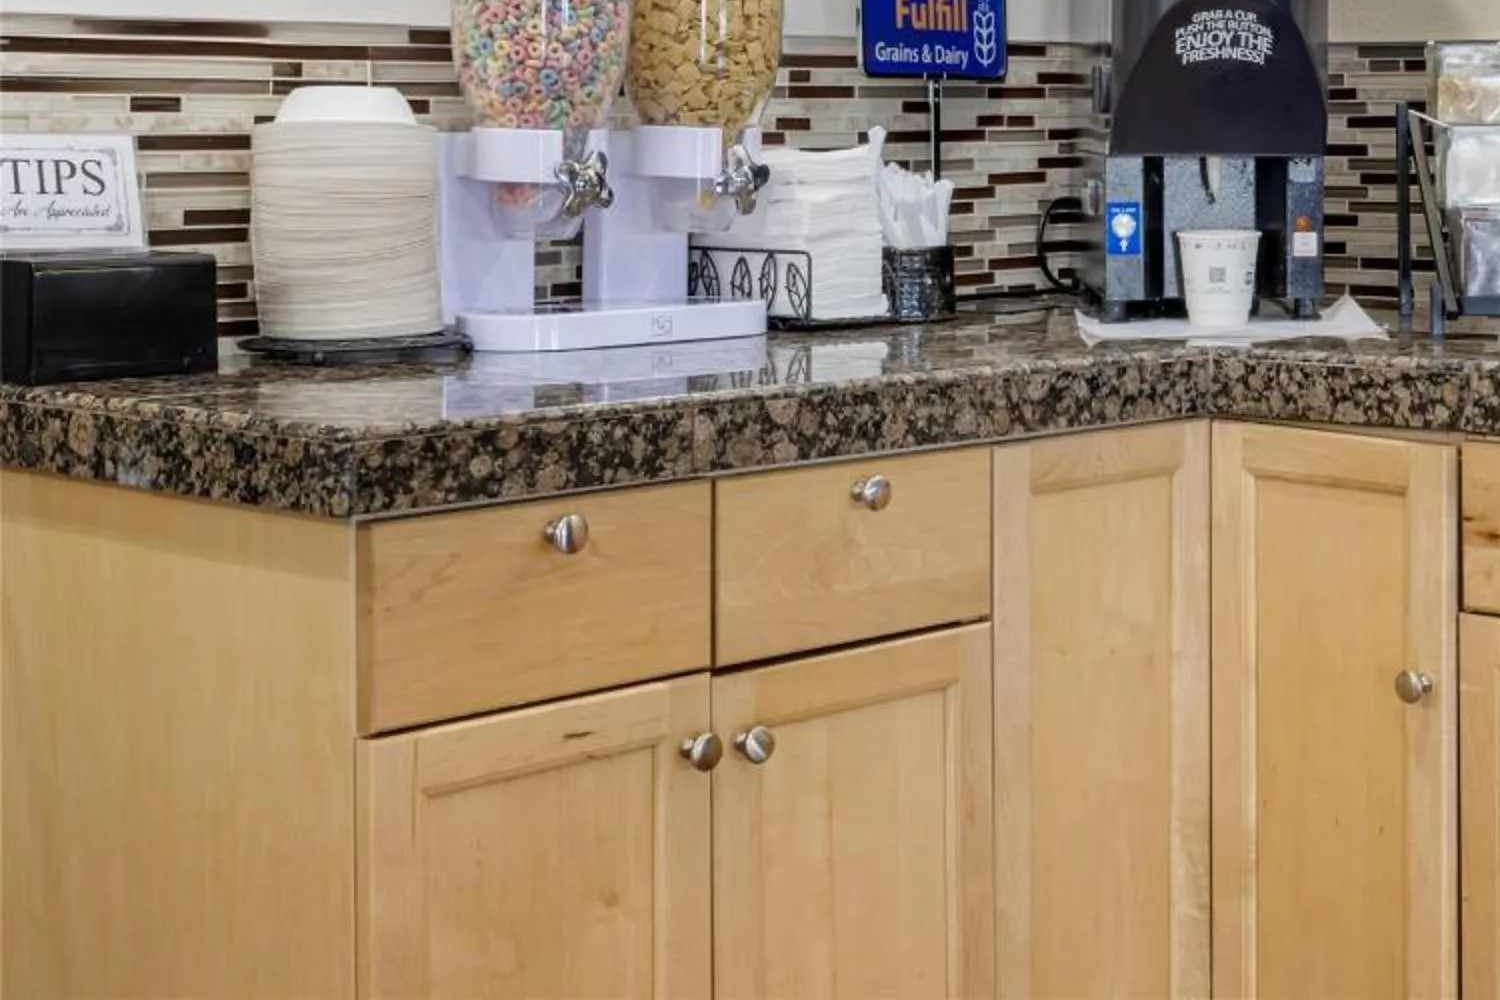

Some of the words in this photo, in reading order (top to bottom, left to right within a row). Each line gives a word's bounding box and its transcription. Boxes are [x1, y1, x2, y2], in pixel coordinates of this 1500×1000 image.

[1203, 20, 1227, 31] THE
[875, 41, 919, 64] Grains
[922, 44, 932, 64] &
[935, 45, 969, 70] Dairy
[1175, 30, 1235, 55] ENJOY
[1237, 31, 1273, 55] THE
[0, 158, 106, 196] TIPS
